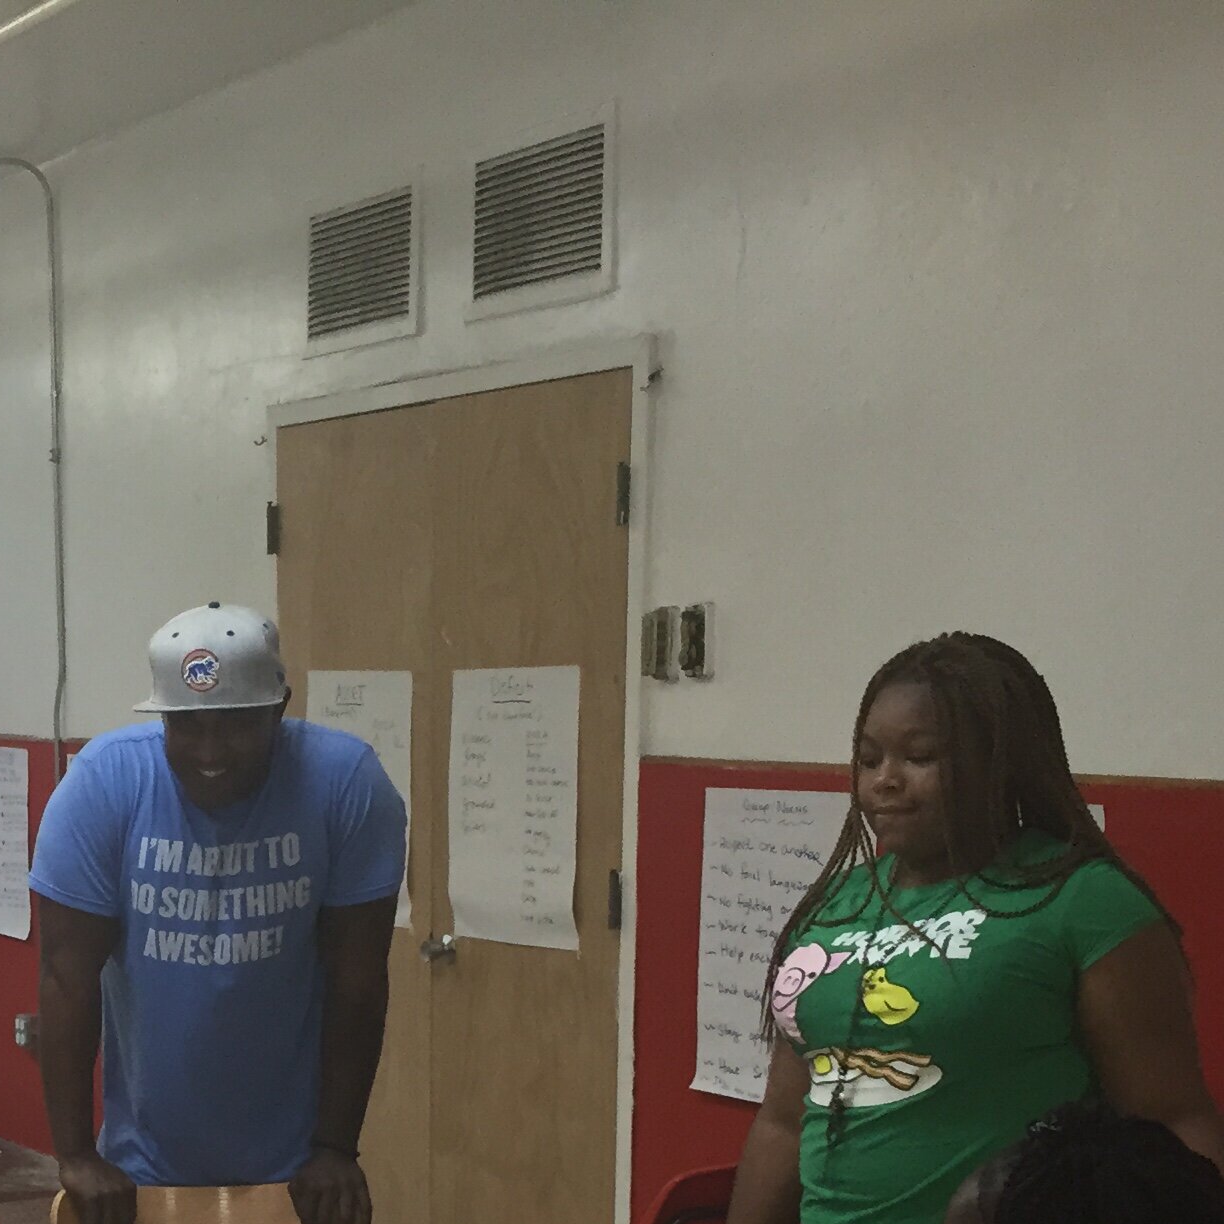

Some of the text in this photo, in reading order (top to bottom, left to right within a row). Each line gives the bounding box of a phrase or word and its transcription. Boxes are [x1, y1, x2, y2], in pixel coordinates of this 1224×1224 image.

[138, 837, 184, 872] I'M
[264, 831, 303, 870] TO
[158, 875, 312, 922] SOMETHING
[143, 924, 285, 967] AWESOME!
